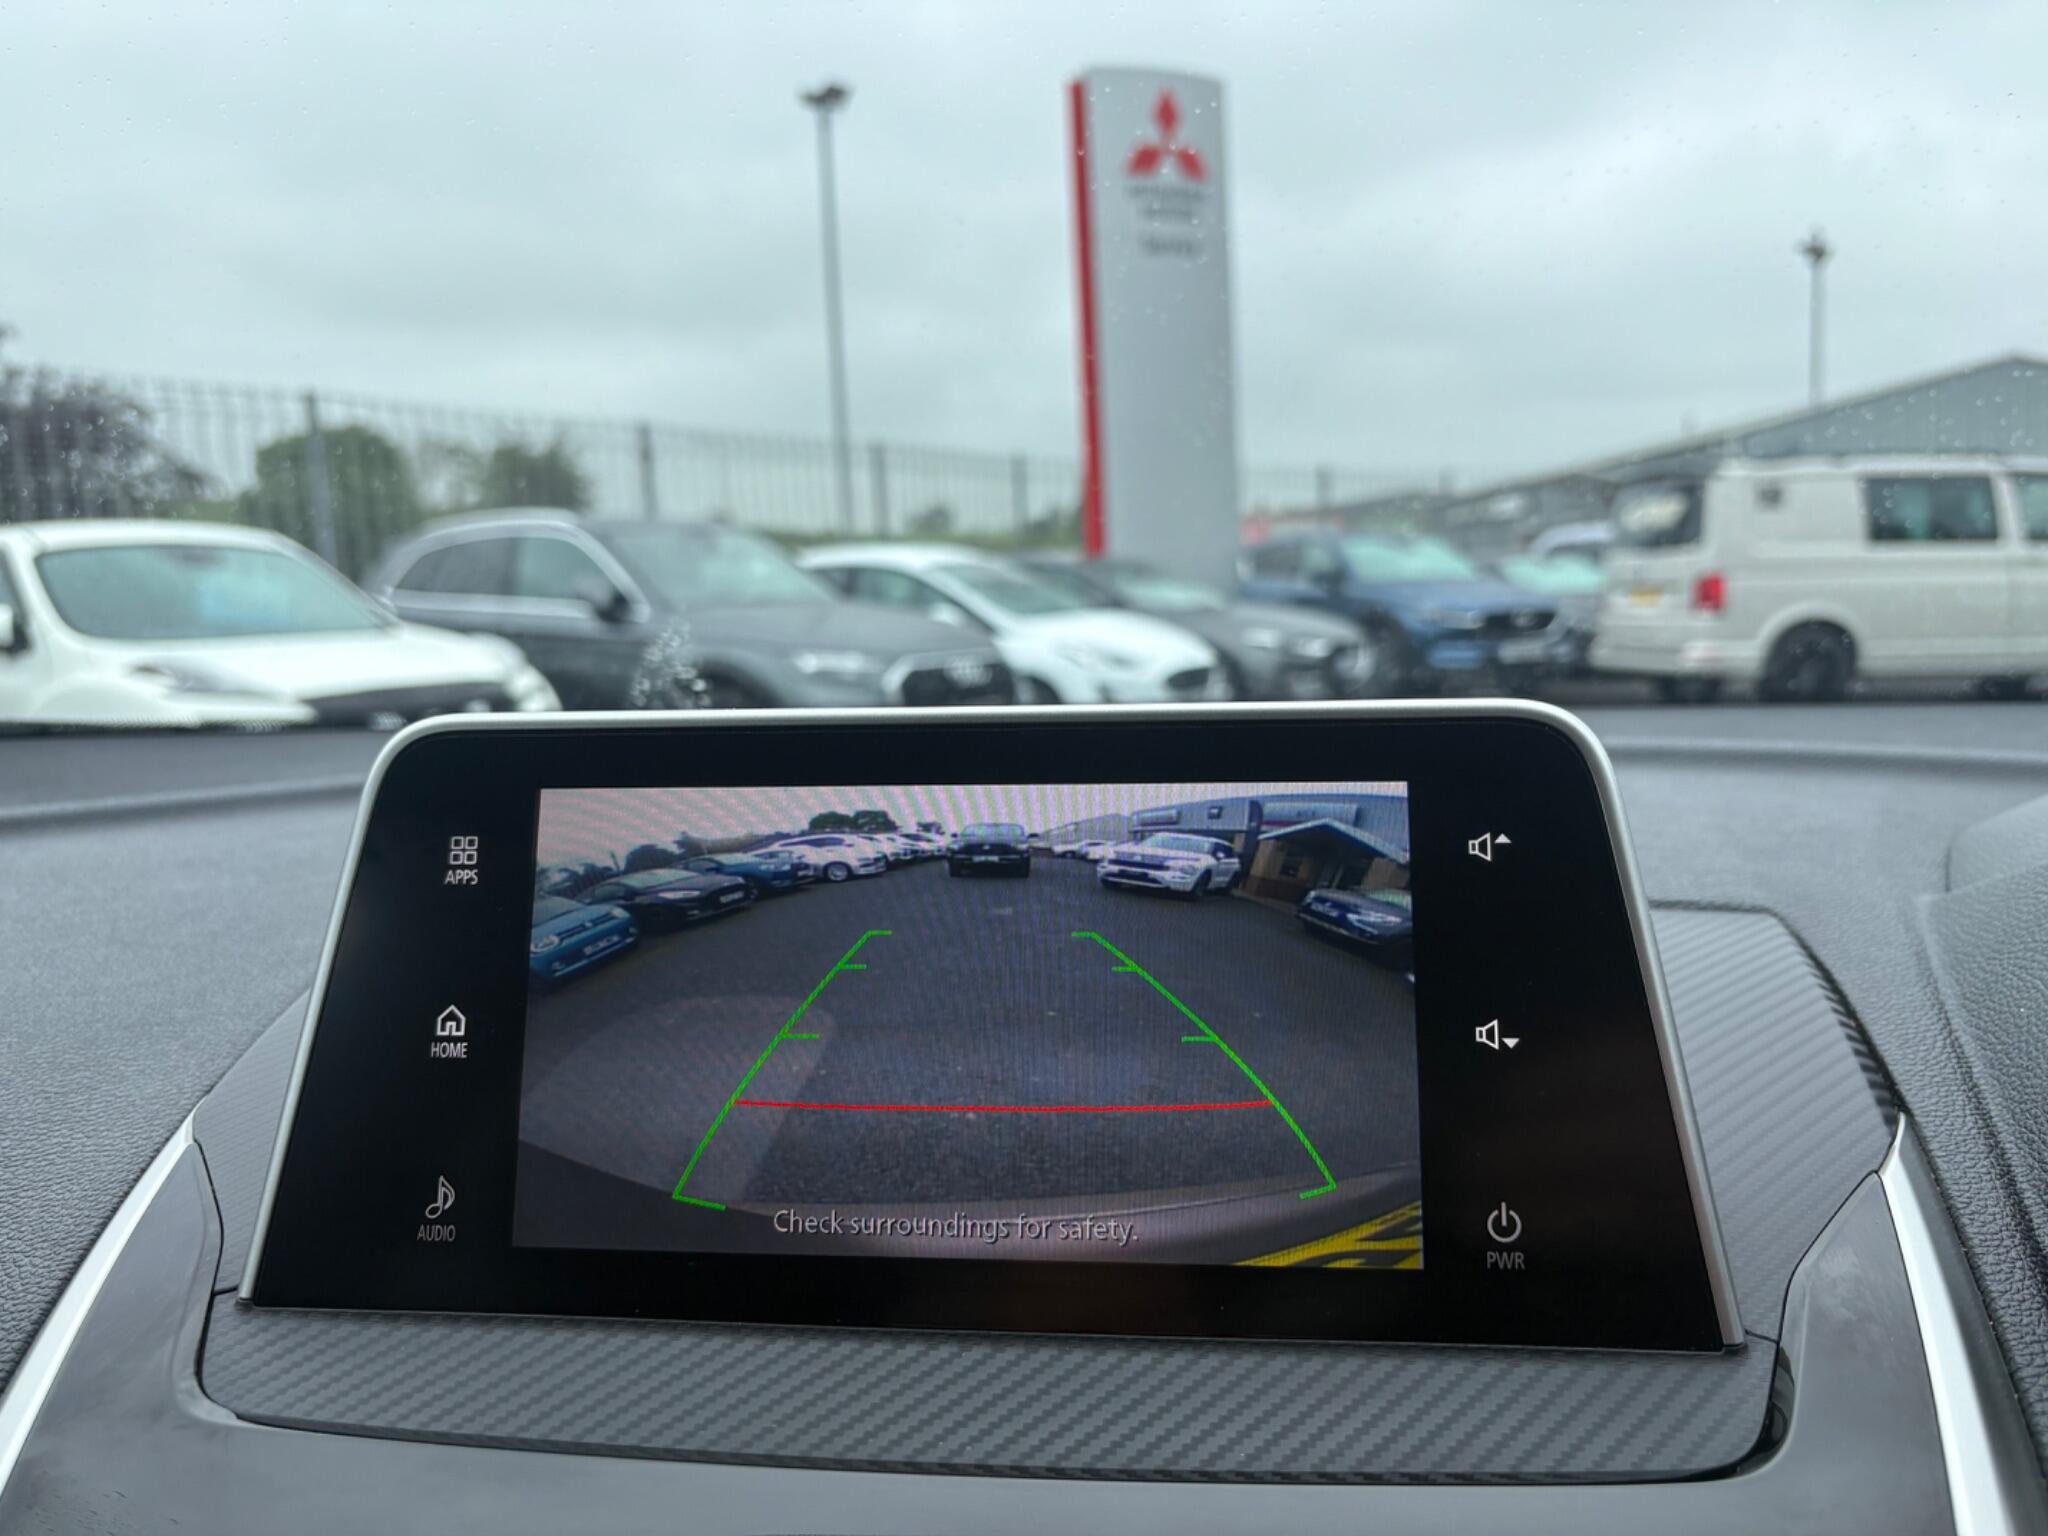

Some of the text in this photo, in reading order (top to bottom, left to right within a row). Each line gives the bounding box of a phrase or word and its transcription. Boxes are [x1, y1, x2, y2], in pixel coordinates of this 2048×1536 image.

[444, 869, 479, 886] APPS
[430, 1041, 468, 1059] HOME
[416, 1224, 457, 1243] AUDIO
[773, 1208, 1140, 1248] Check surroundings for safety.
[1486, 1251, 1526, 1270] PWR
